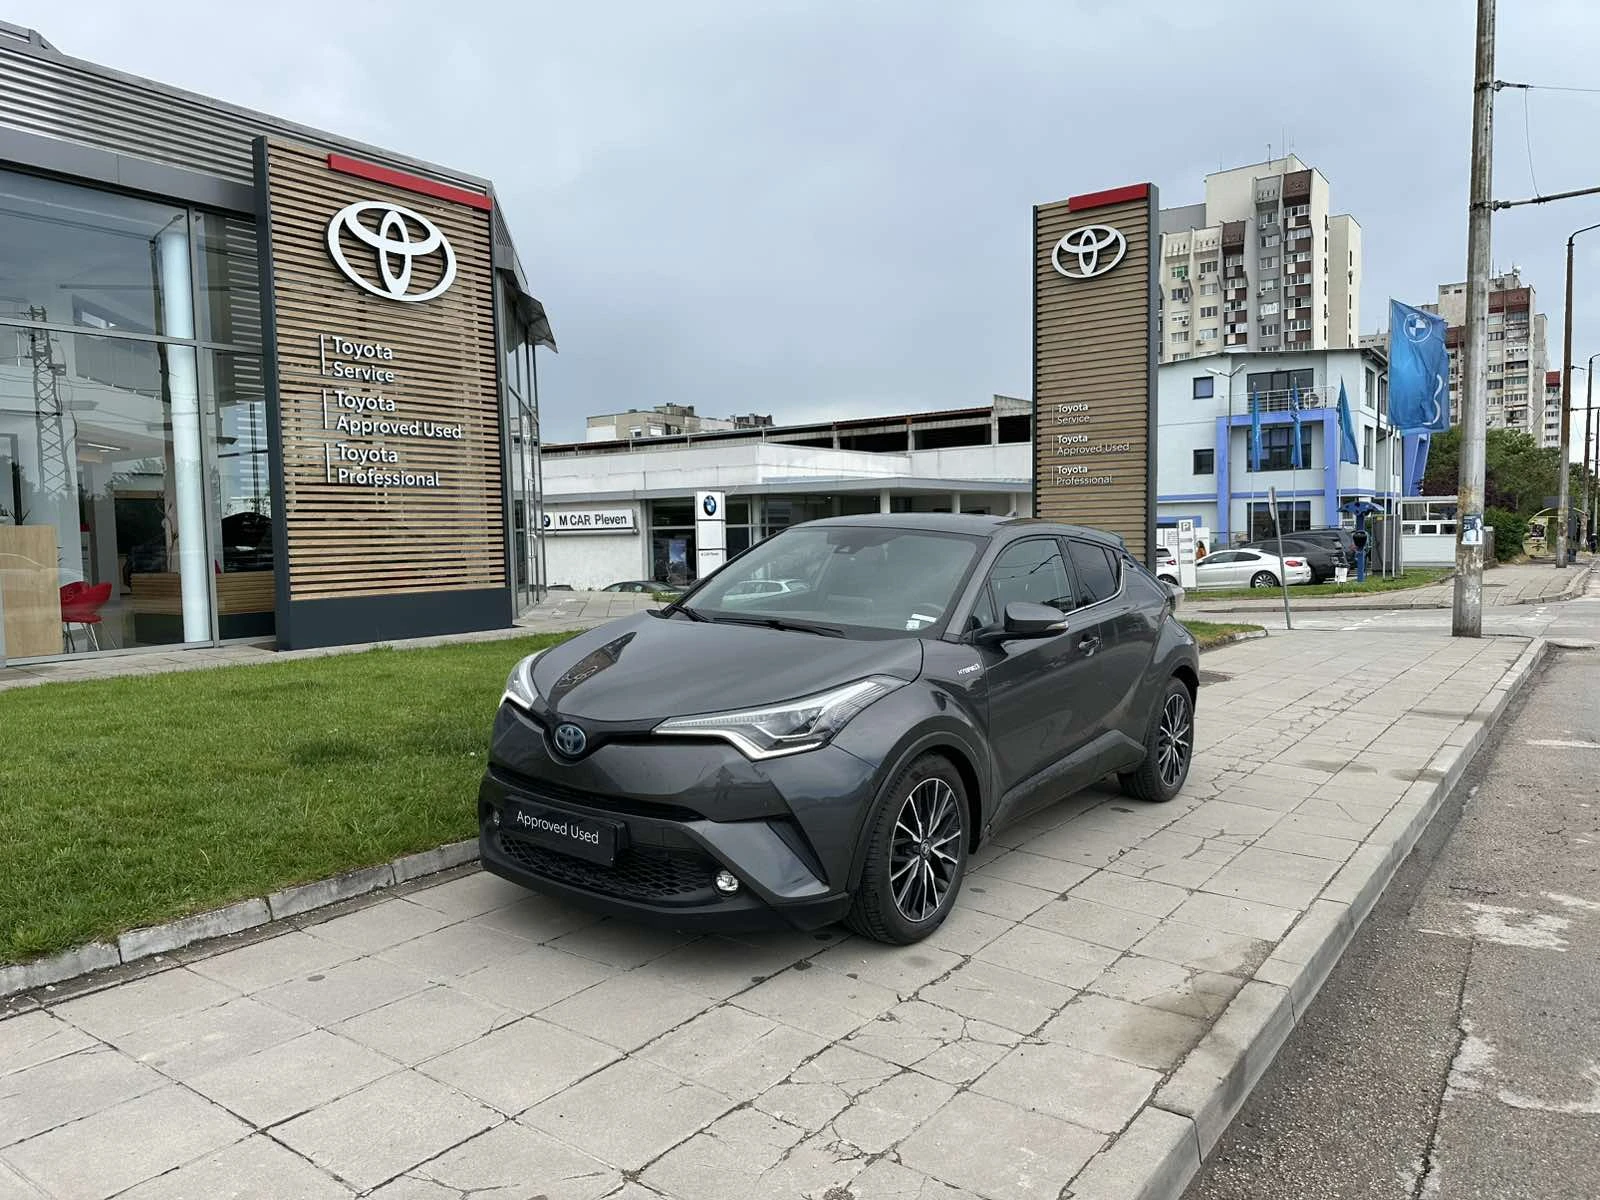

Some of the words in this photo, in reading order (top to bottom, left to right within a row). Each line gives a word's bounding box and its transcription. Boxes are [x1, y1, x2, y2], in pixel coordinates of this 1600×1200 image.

[332, 336, 393, 359] Toyota
[333, 361, 395, 382] Service
[334, 390, 396, 412] Toyota
[1058, 403, 1089, 414] Toyota
[336, 415, 420, 436] Approved
[423, 421, 462, 439] Used
[1057, 414, 1090, 425] Service
[1057, 434, 1088, 445] Toyota
[337, 442, 398, 465] Toyota
[1057, 445, 1102, 457] Approved
[1105, 443, 1129, 452] Used
[338, 467, 440, 486] Professional
[1057, 465, 1088, 476] Toyota
[1056, 475, 1112, 486] Professional
[559, 514, 568, 526] M
[569, 514, 591, 526] CAR
[594, 513, 627, 526] Pleven
[516, 810, 568, 835] Approved
[570, 824, 600, 845] Used
